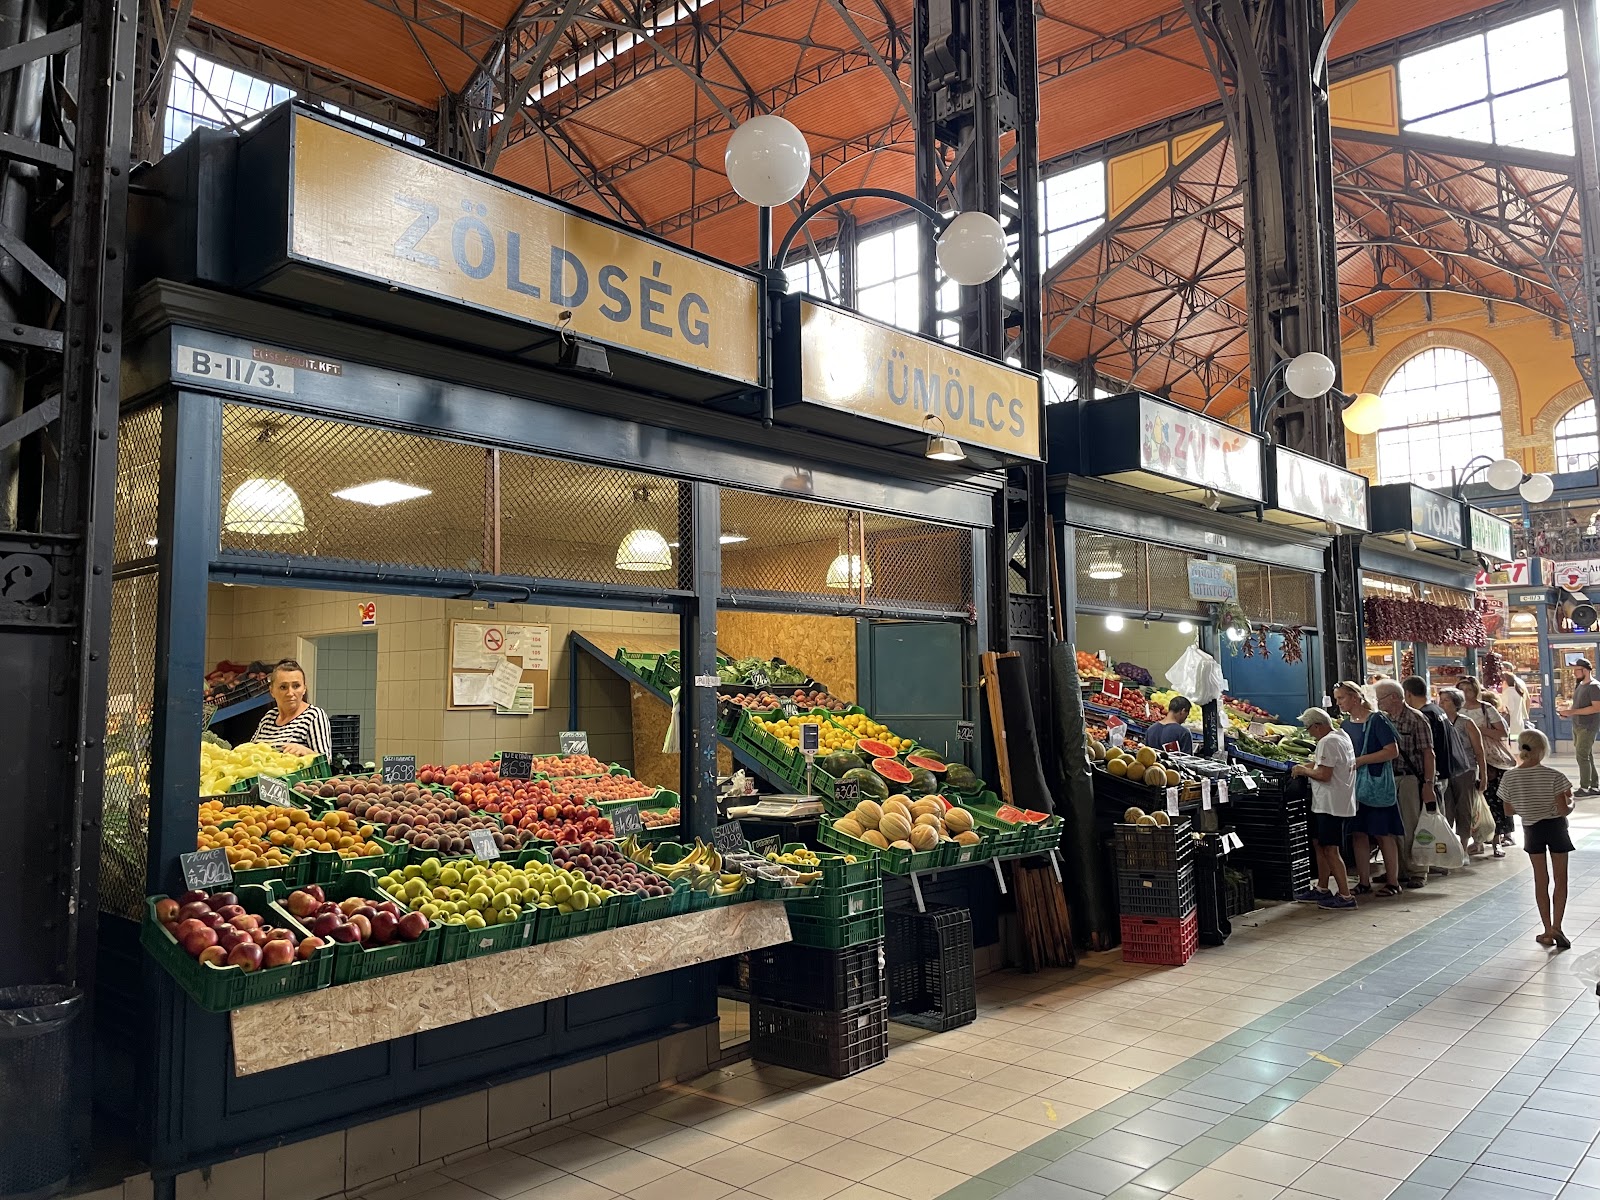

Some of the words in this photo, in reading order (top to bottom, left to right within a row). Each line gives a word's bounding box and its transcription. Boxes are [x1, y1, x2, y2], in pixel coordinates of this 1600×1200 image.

[394, 194, 710, 348] ZÖLDSÉG
[319, 362, 341, 375] KFT.
[864, 349, 1025, 437] YÜMÖLCS
[391, 764, 415, 782] 698
[509, 760, 531, 776] 698
